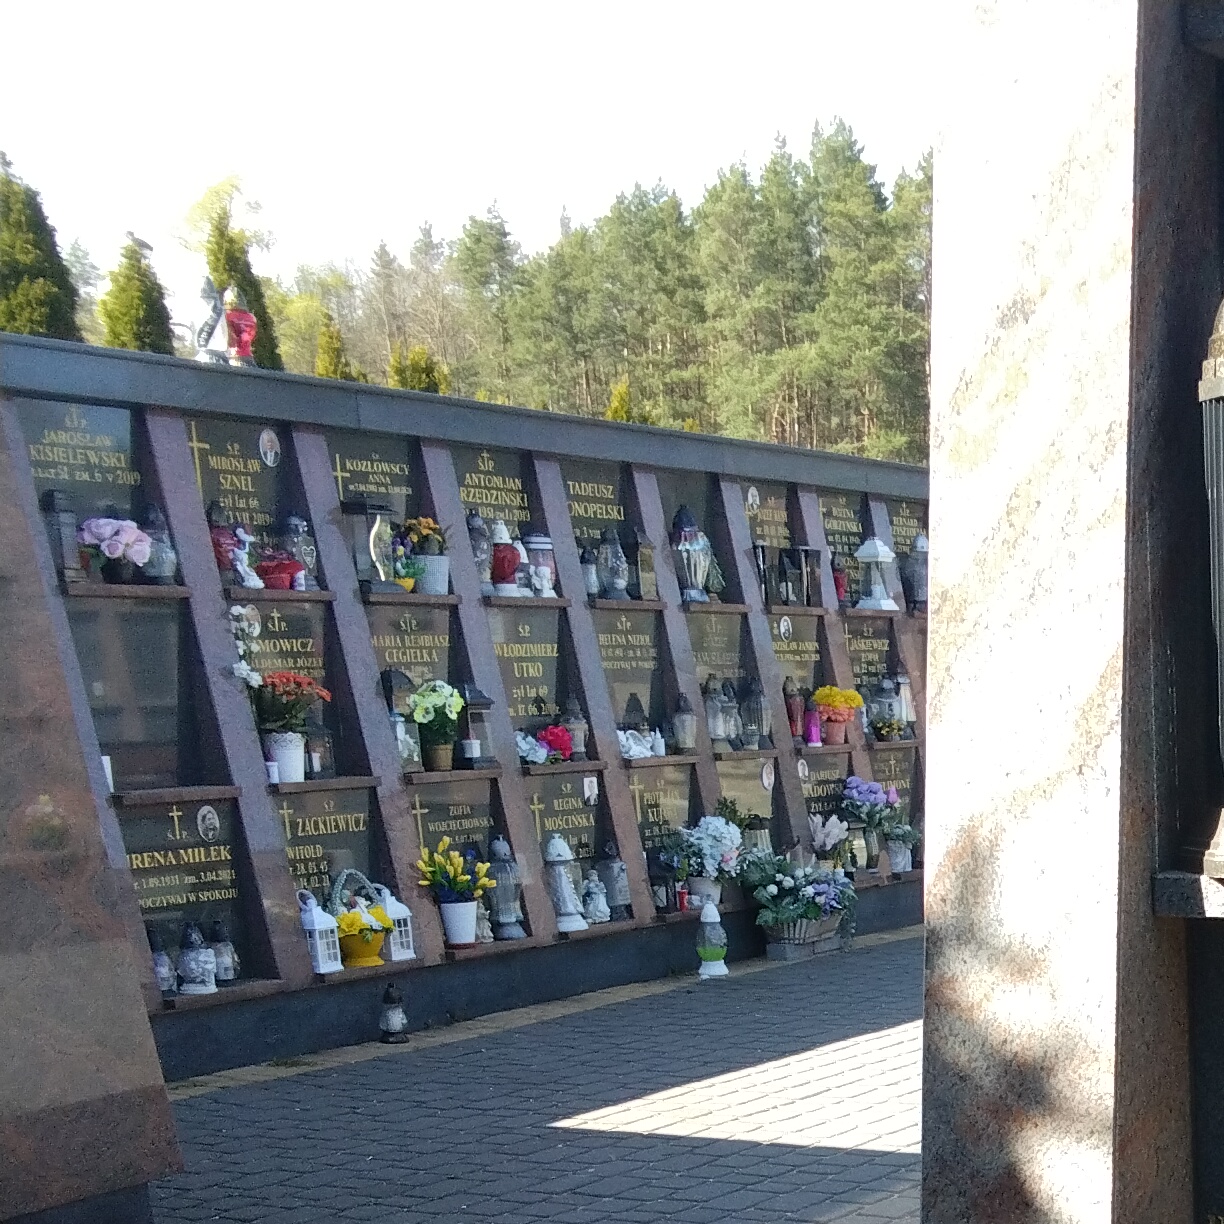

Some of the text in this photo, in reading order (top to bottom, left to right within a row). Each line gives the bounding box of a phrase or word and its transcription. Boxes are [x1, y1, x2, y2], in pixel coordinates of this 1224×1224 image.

[219, 473, 256, 492] SZNEL
[567, 480, 615, 499] TADEUSZ
[567, 500, 625, 521] ONOPELSKI
[257, 637, 316, 654] MOWICZ
[493, 643, 559, 658] WŁODZIMIERZ
[513, 661, 543, 678] UTKO
[553, 797, 583, 811] REGINA
[285, 844, 323, 860] WITOLD
